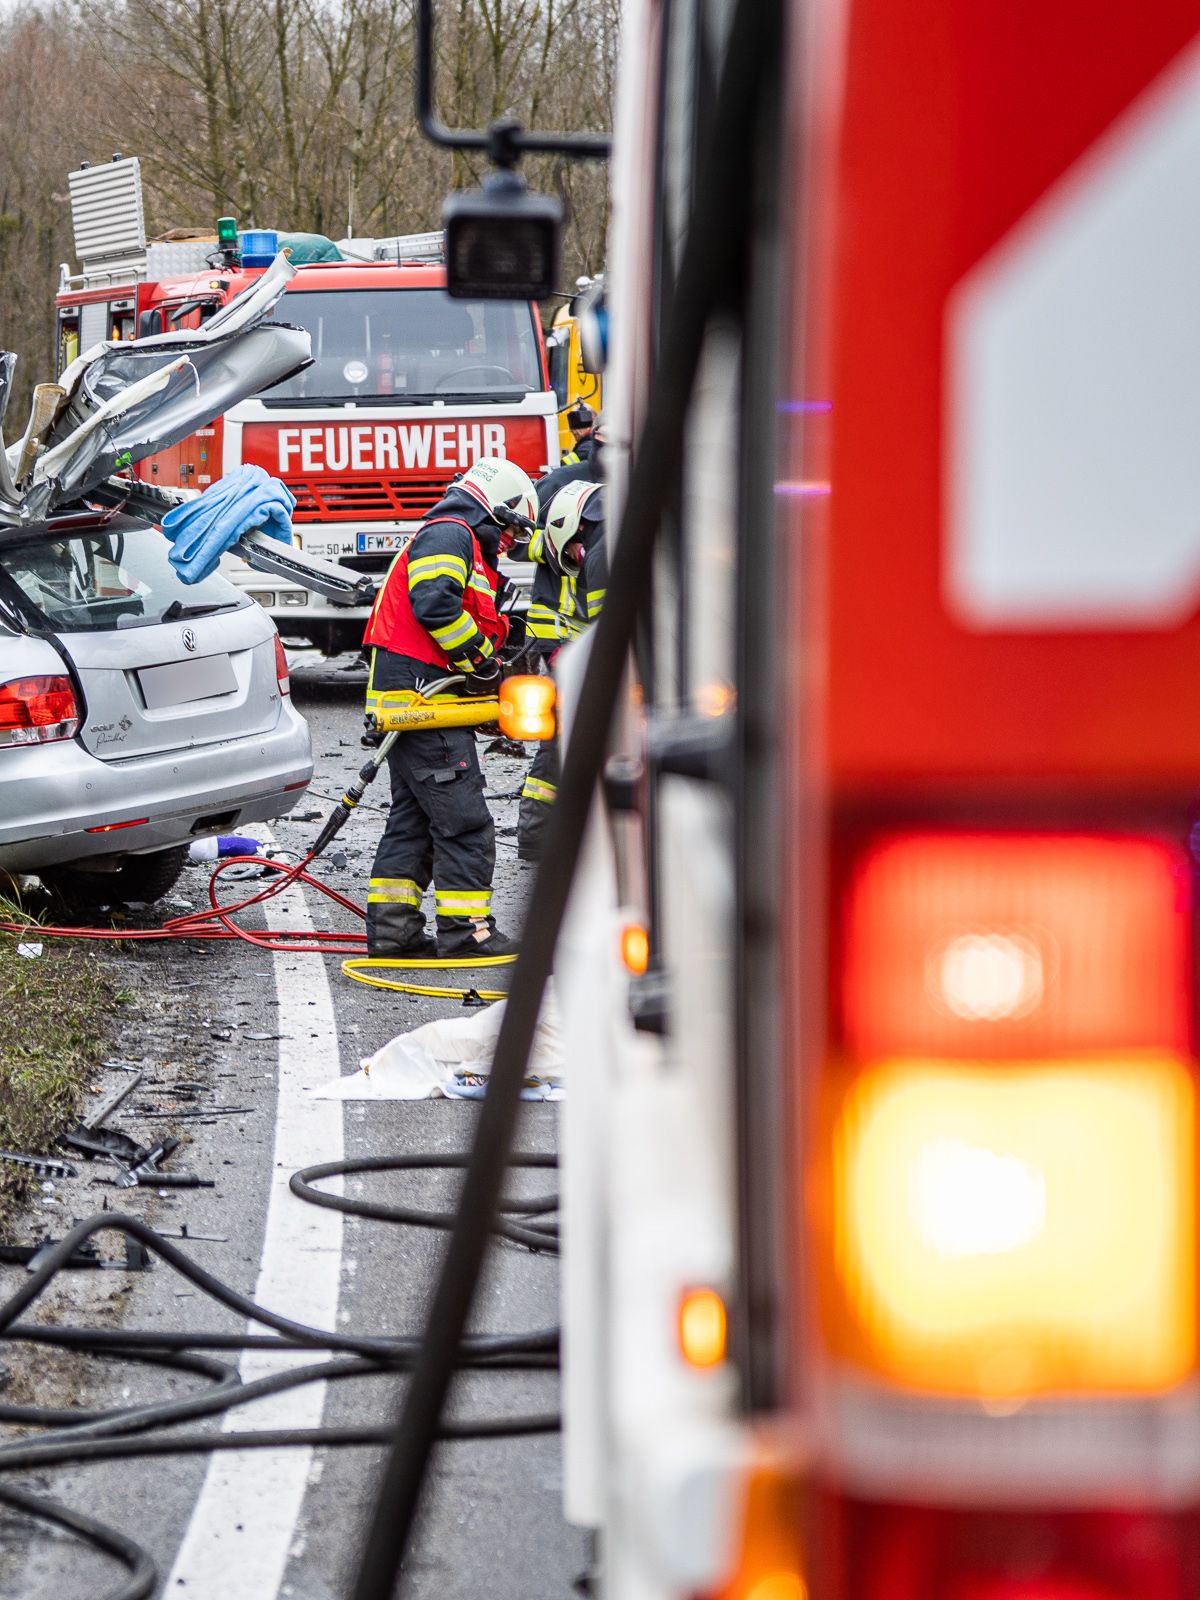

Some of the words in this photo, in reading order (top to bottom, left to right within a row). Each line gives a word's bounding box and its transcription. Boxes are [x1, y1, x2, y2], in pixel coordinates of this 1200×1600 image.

[278, 424, 507, 472] FEUERWEHR
[367, 536, 385, 549] FW
[90, 724, 114, 733] GOLF
